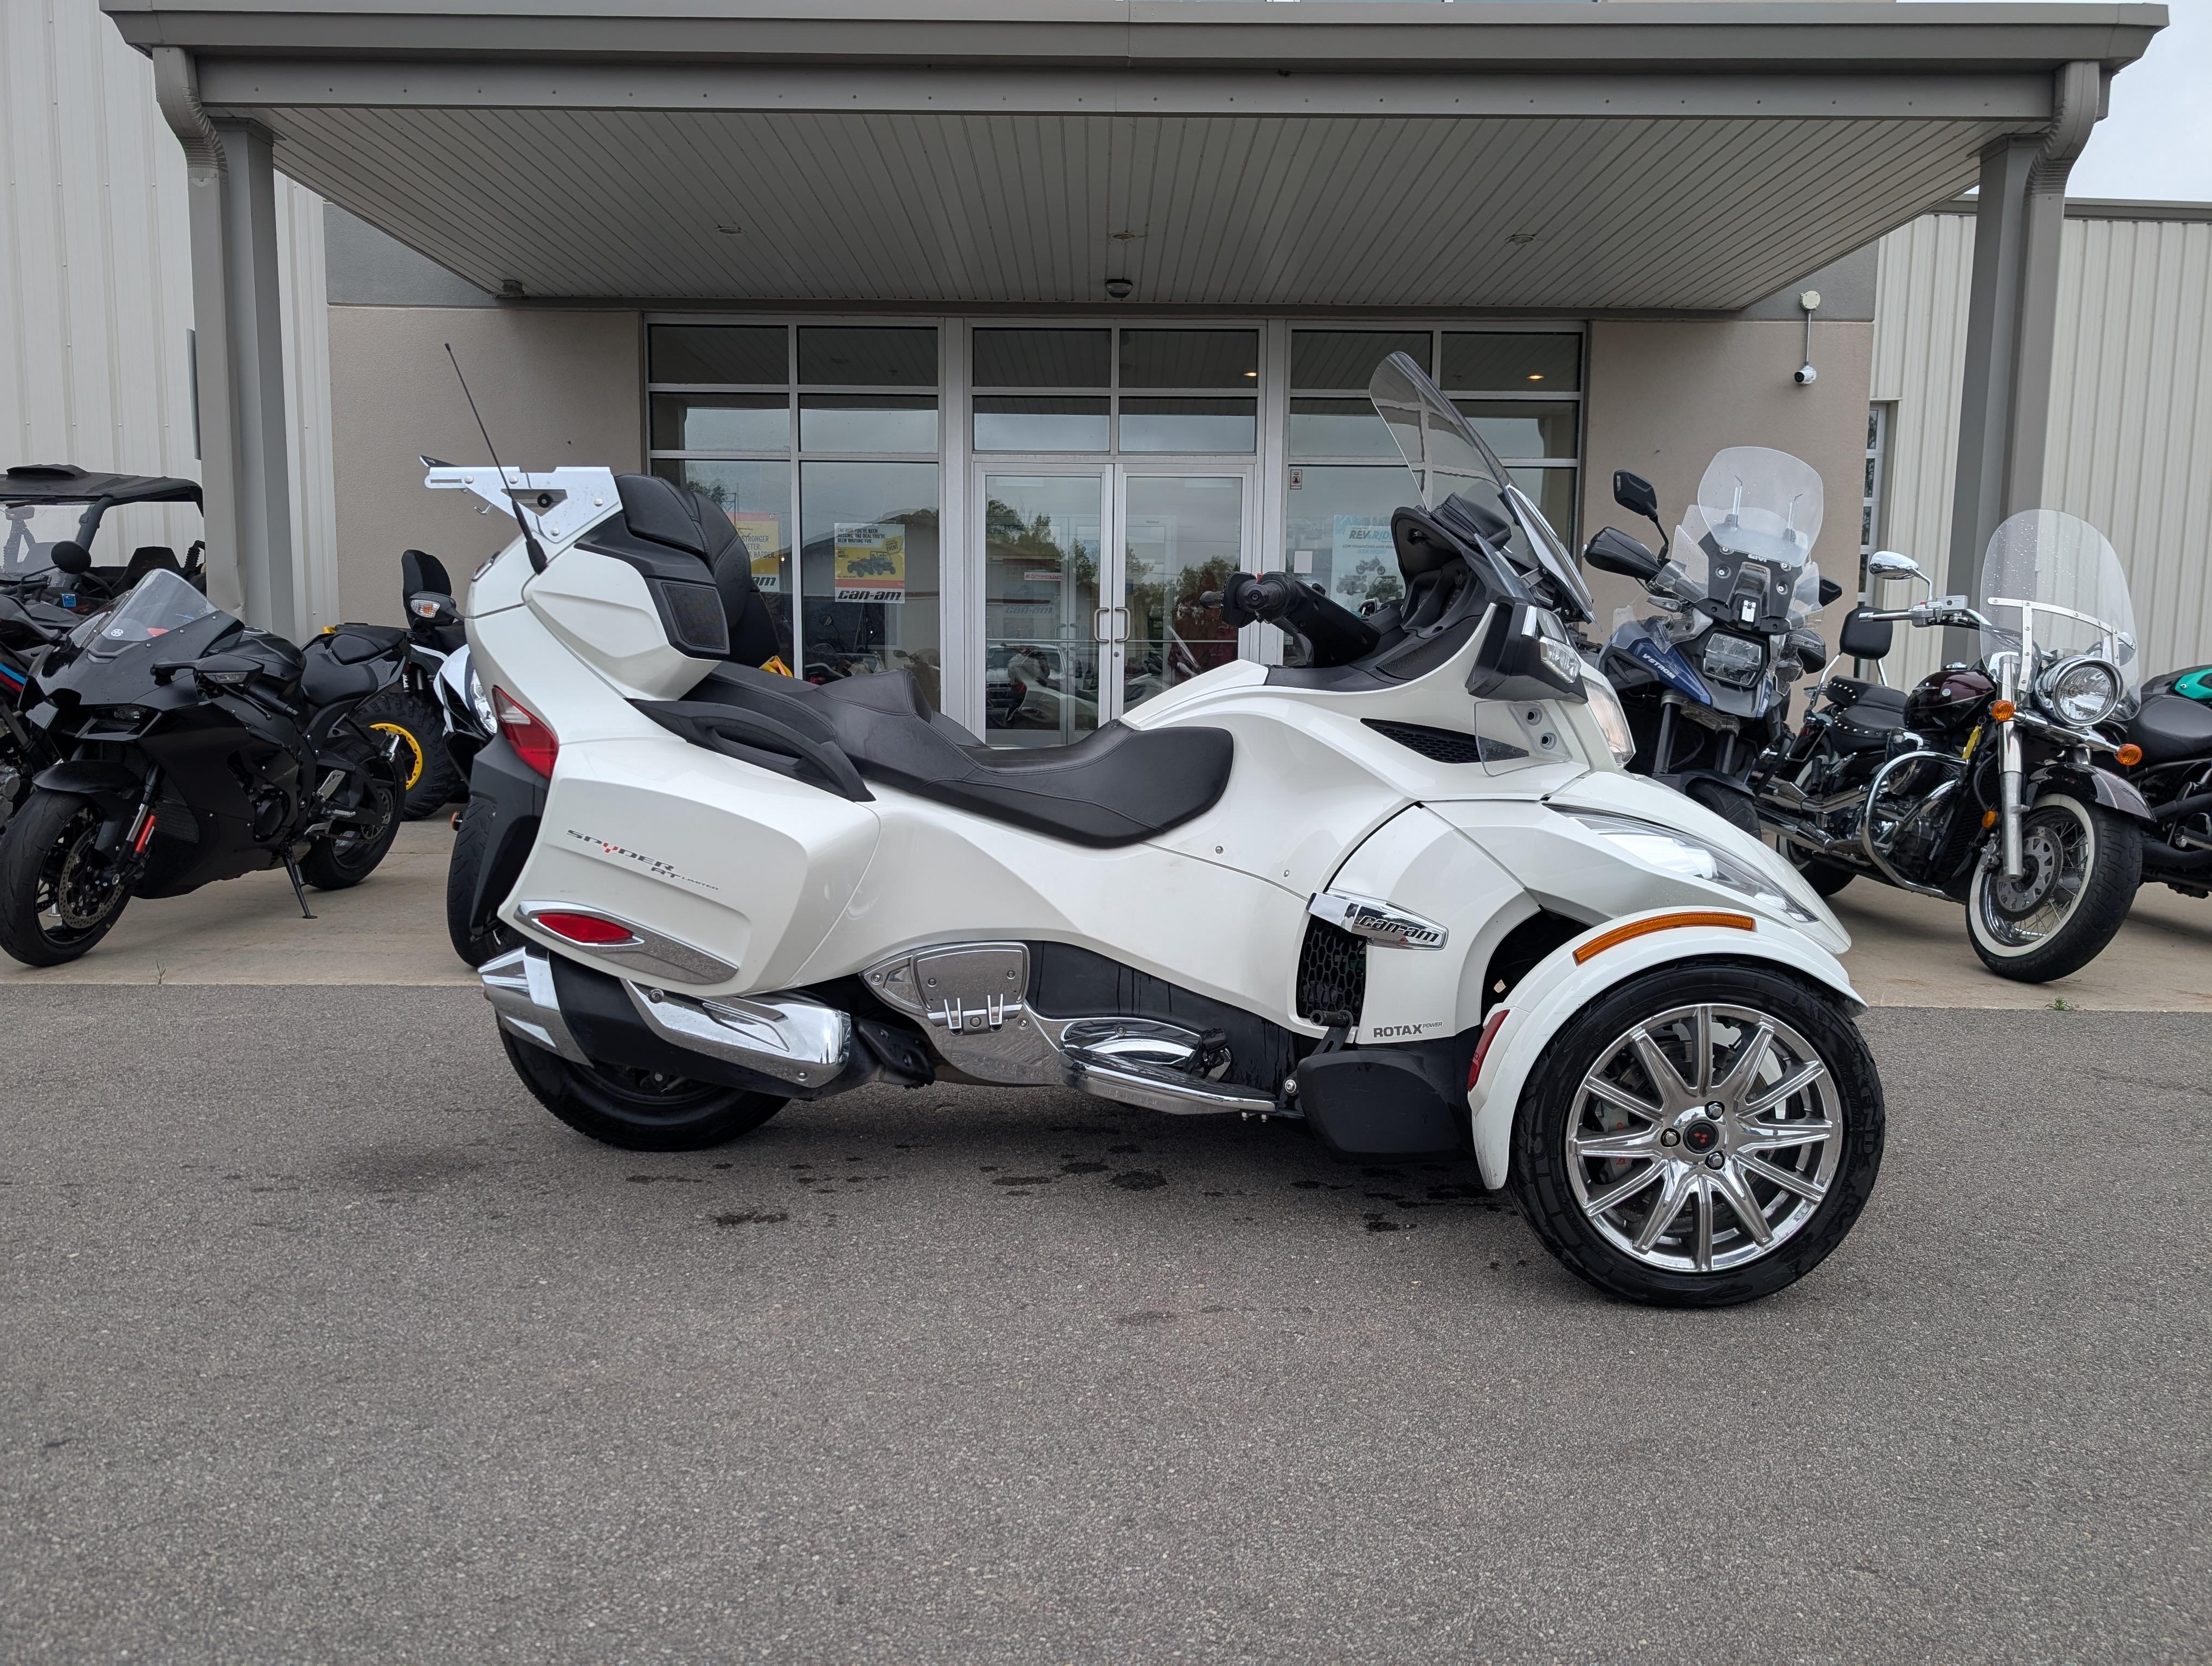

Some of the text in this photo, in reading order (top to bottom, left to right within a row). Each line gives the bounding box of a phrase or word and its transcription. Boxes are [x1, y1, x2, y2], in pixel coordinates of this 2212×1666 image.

[1372, 531, 1392, 540] RID
[838, 590, 902, 601] can-am
[1642, 653, 1676, 679] V-STROM
[567, 829, 674, 872] SPYDER
[681, 876, 719, 890] LIMITED
[1359, 915, 1440, 943] can-am
[1373, 1023, 1423, 1038] ROTAX
